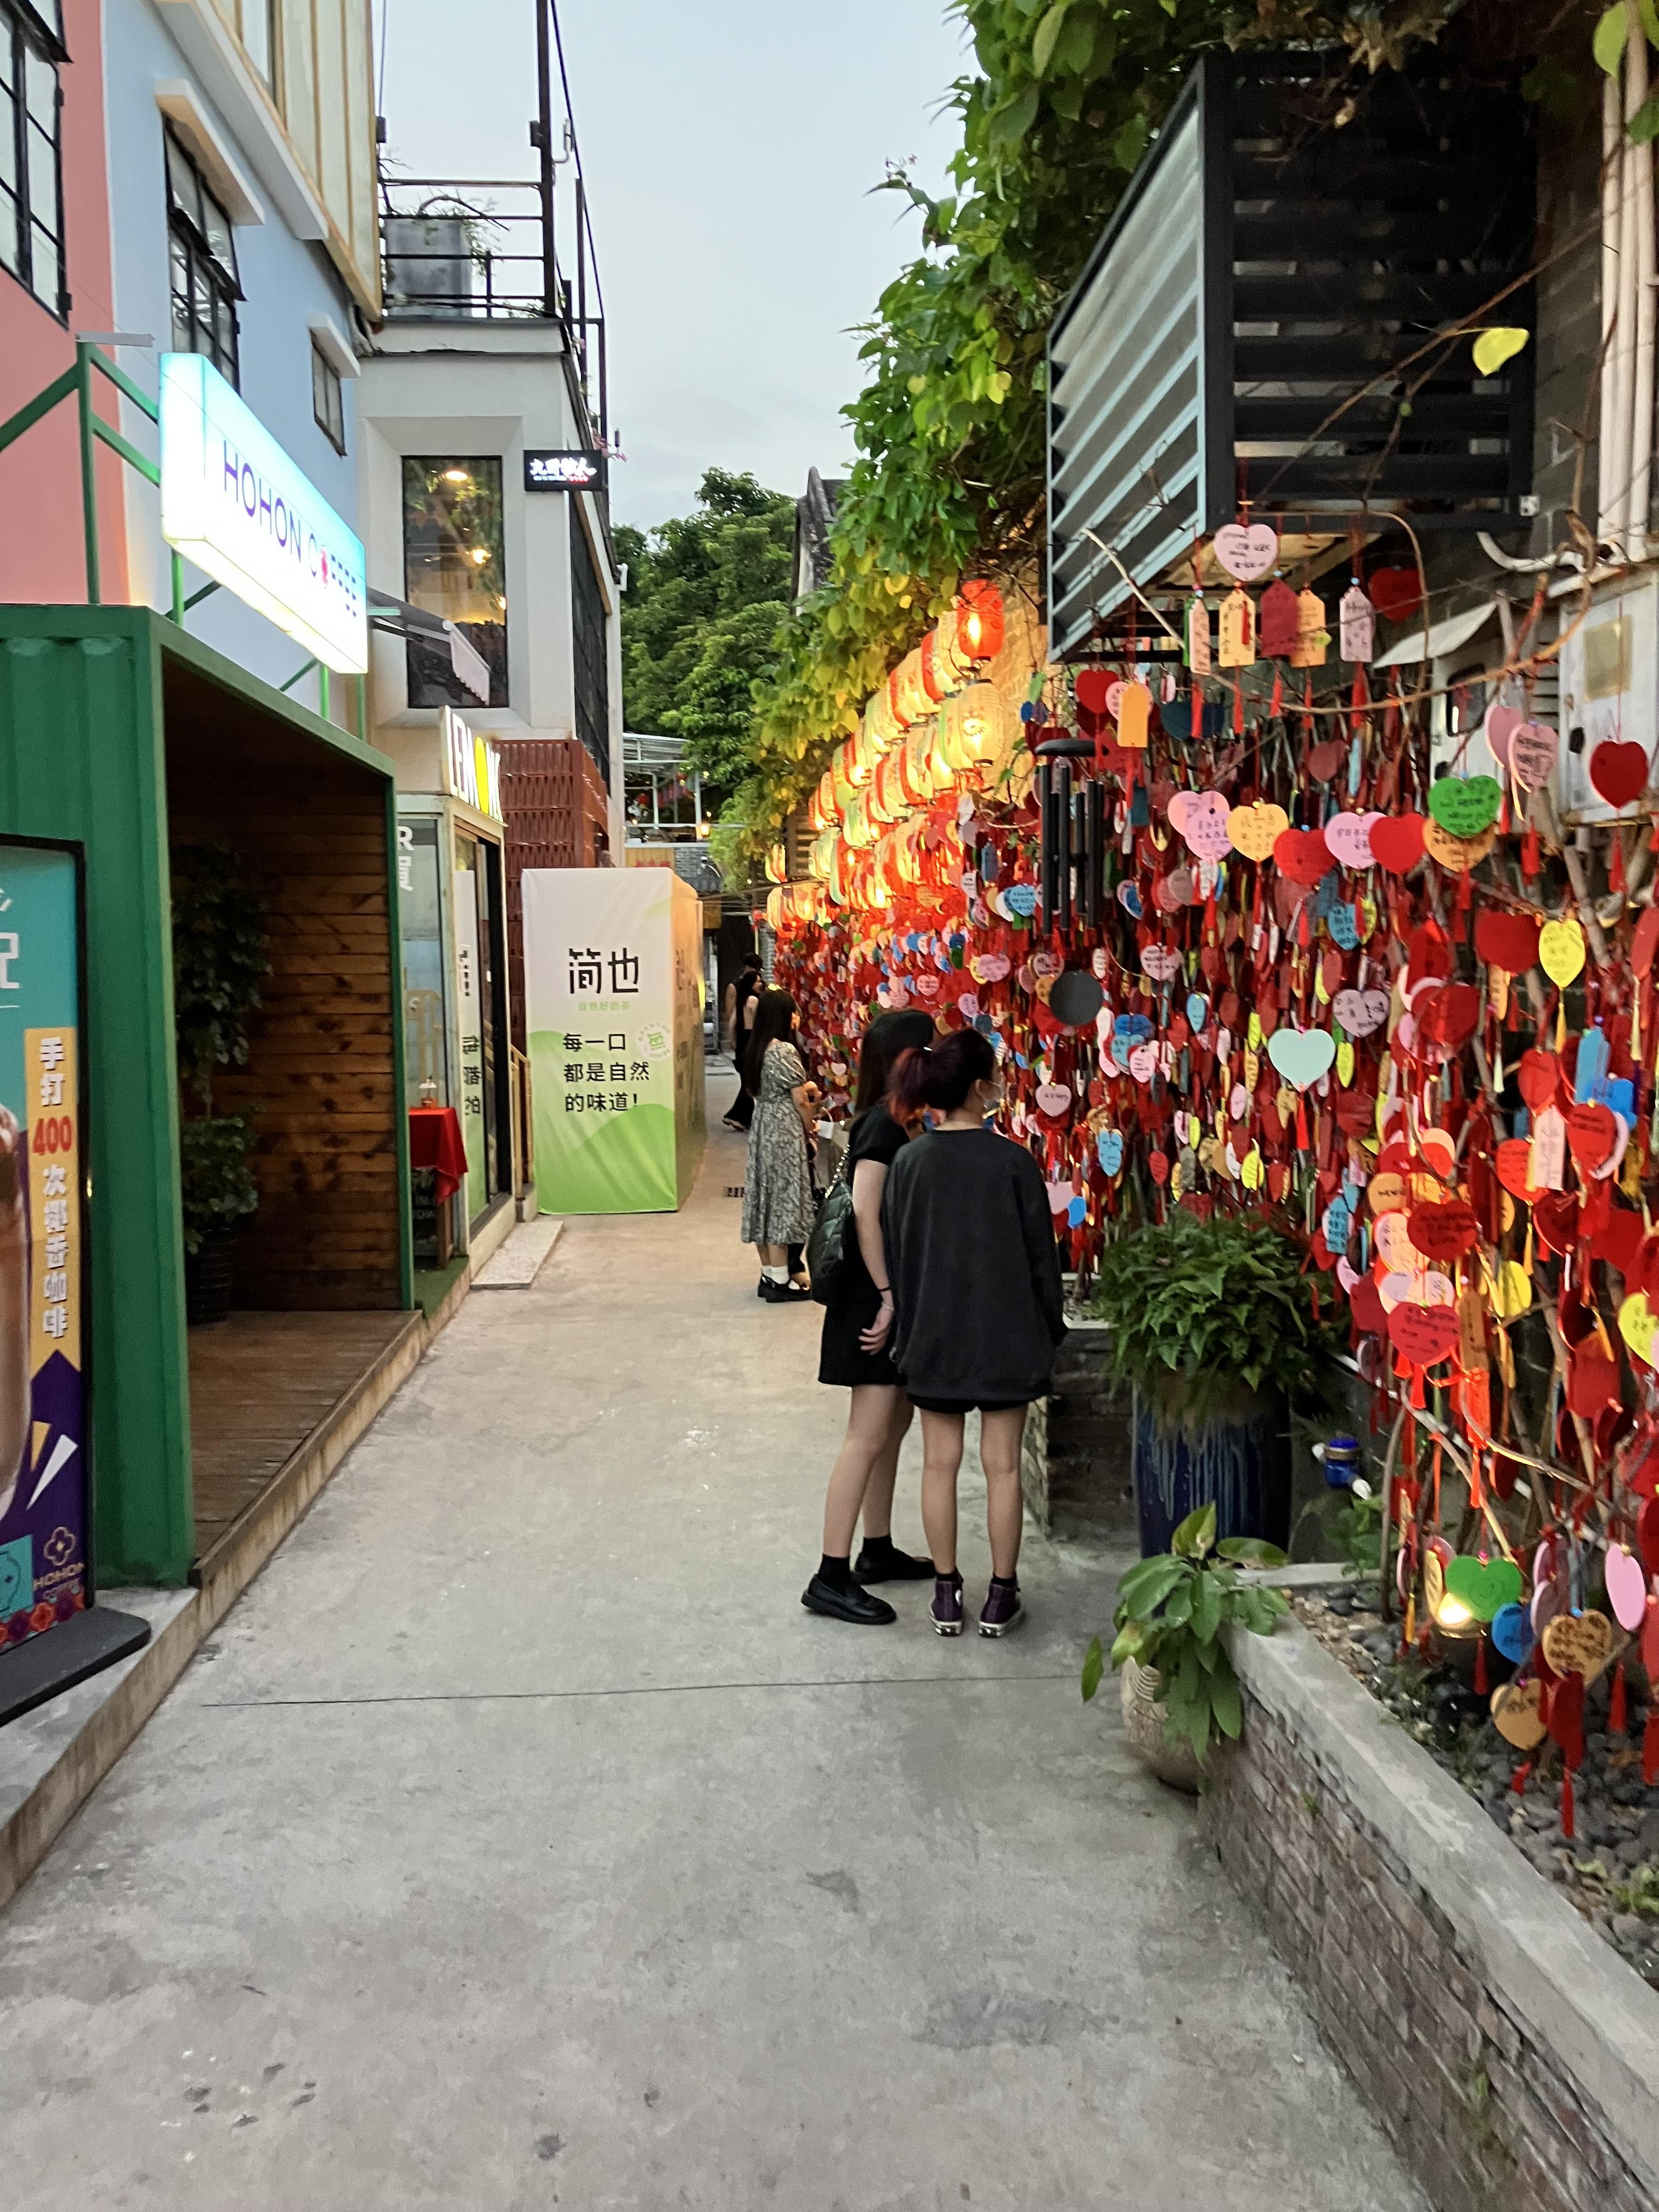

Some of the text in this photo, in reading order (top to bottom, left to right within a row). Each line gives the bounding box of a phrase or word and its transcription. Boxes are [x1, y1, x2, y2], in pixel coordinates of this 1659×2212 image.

[224, 439, 301, 563] HOHON
[568, 947, 639, 994] 简也
[563, 1032, 627, 1052] 每一口
[563, 1062, 650, 1082] 都是自然
[565, 1092, 638, 1113] 的味道!
